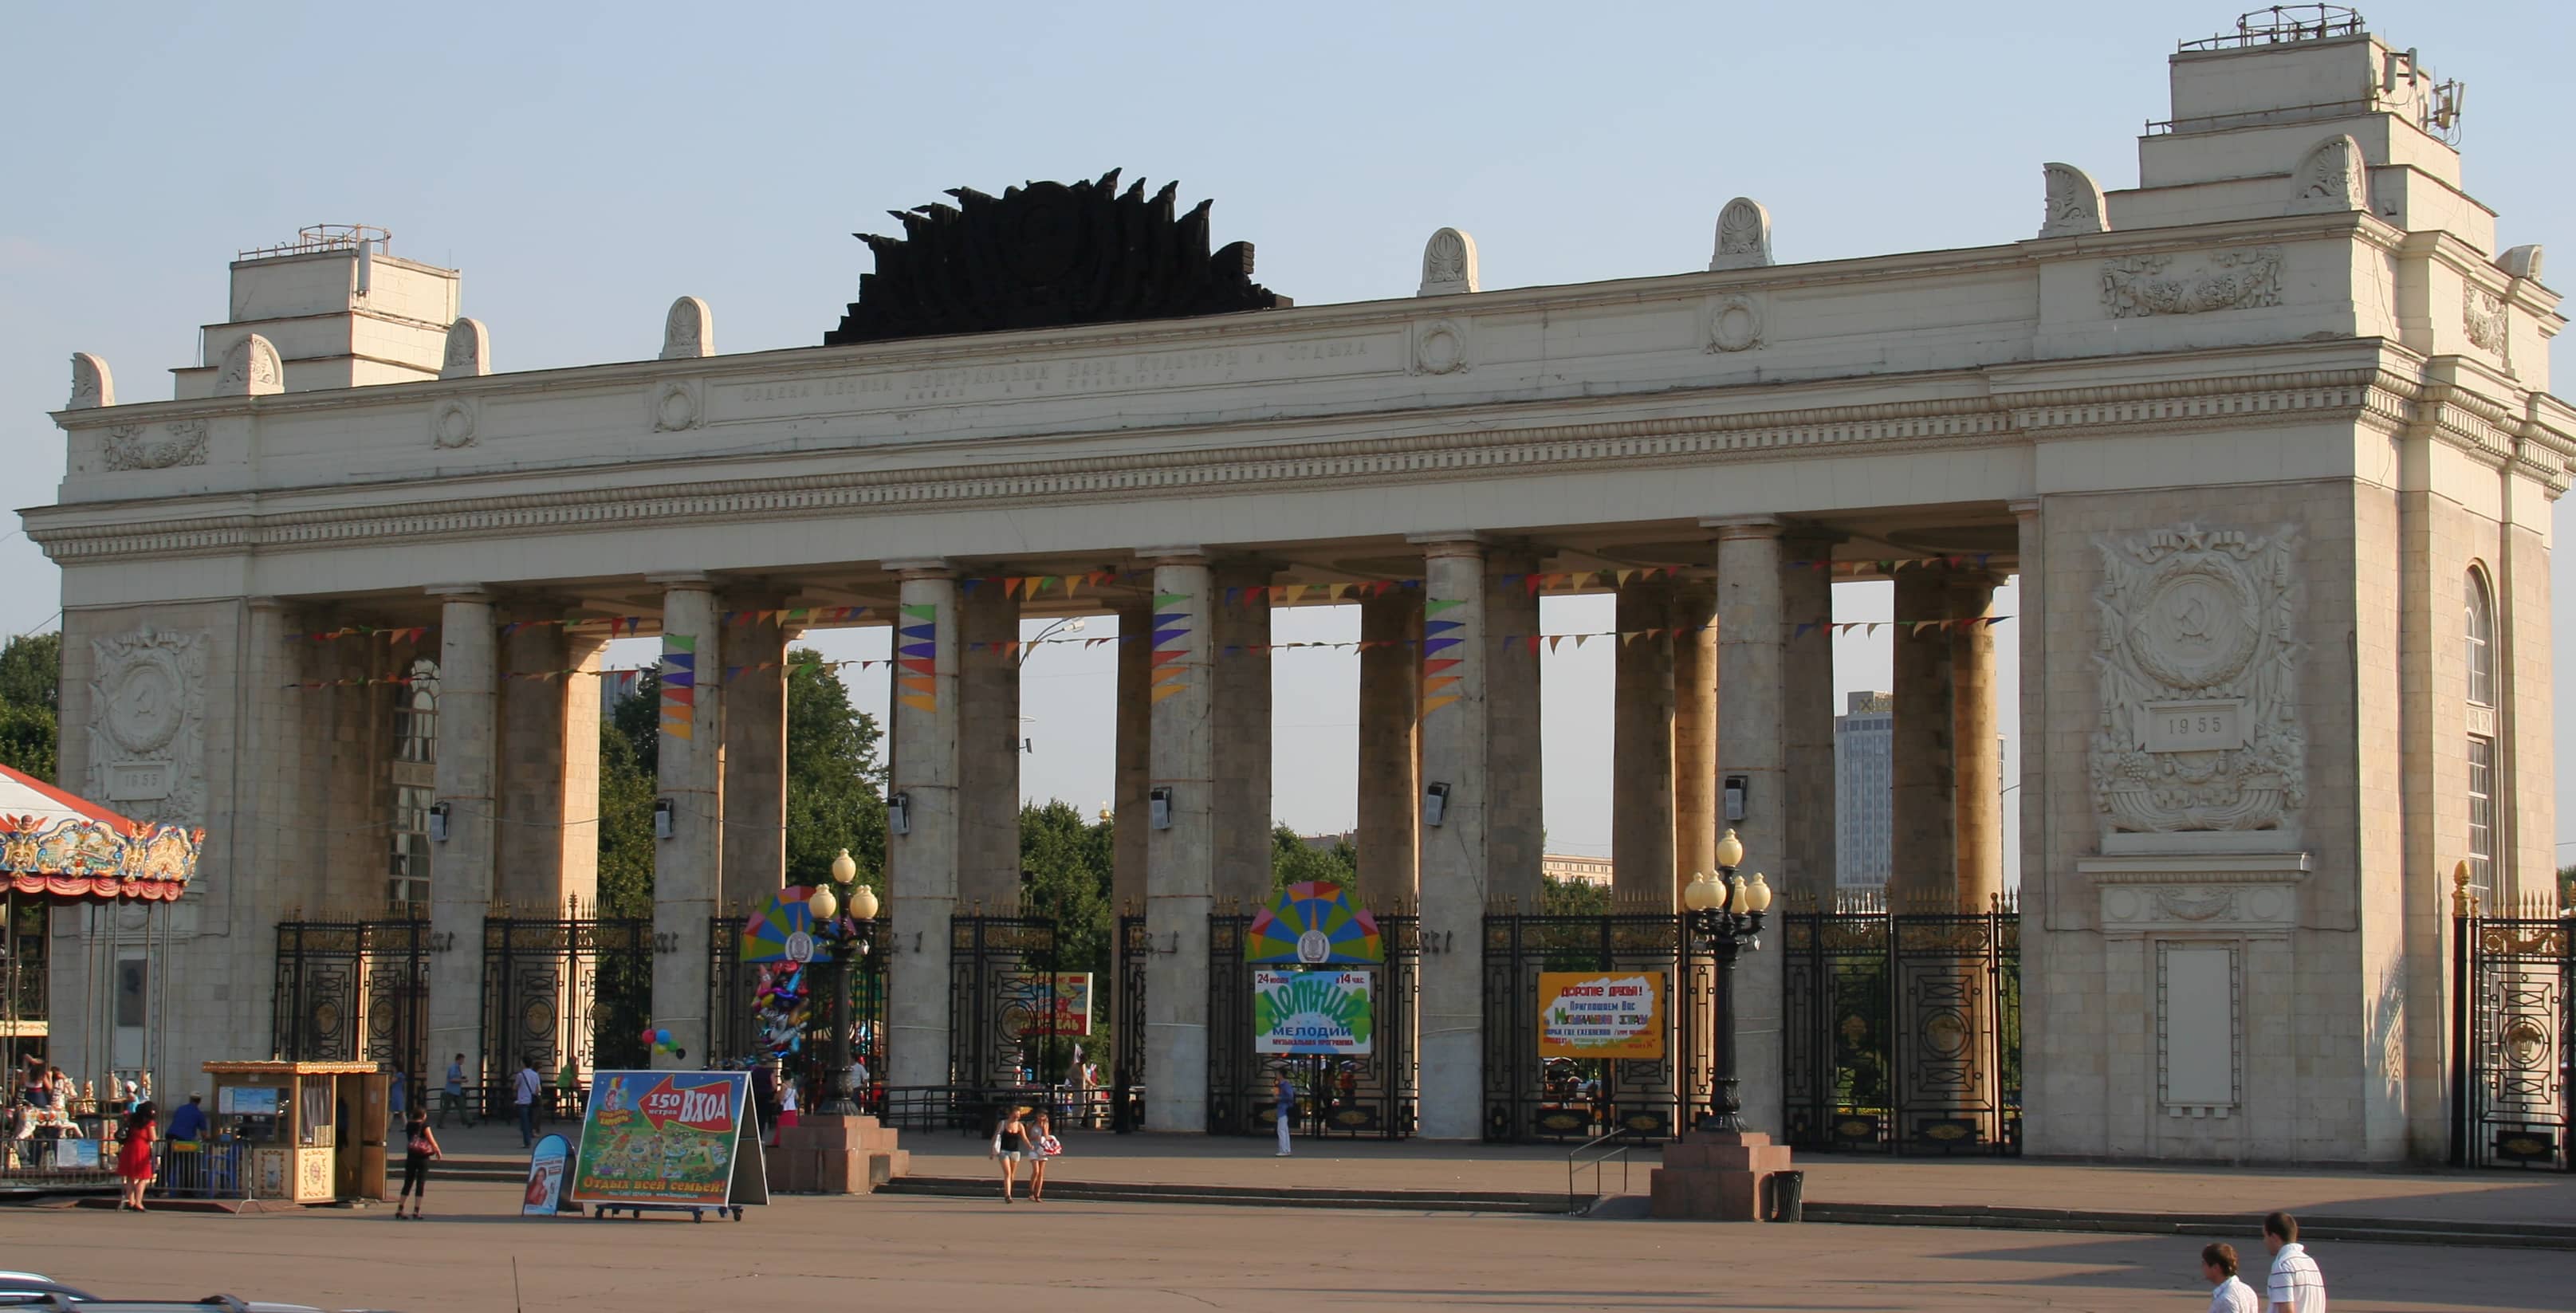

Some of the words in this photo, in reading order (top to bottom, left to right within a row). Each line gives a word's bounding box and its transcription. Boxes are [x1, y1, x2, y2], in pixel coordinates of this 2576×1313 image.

[2169, 716, 2222, 734] 1955
[1257, 973, 1269, 984] 24
[1340, 974, 1351, 984] 14
[1272, 1026, 1352, 1038] МЕЛОДИИ
[649, 1093, 680, 1108] 150
[678, 1090, 726, 1123] ВХОД
[583, 1176, 629, 1190] Отдых
[634, 1177, 667, 1190] всей
